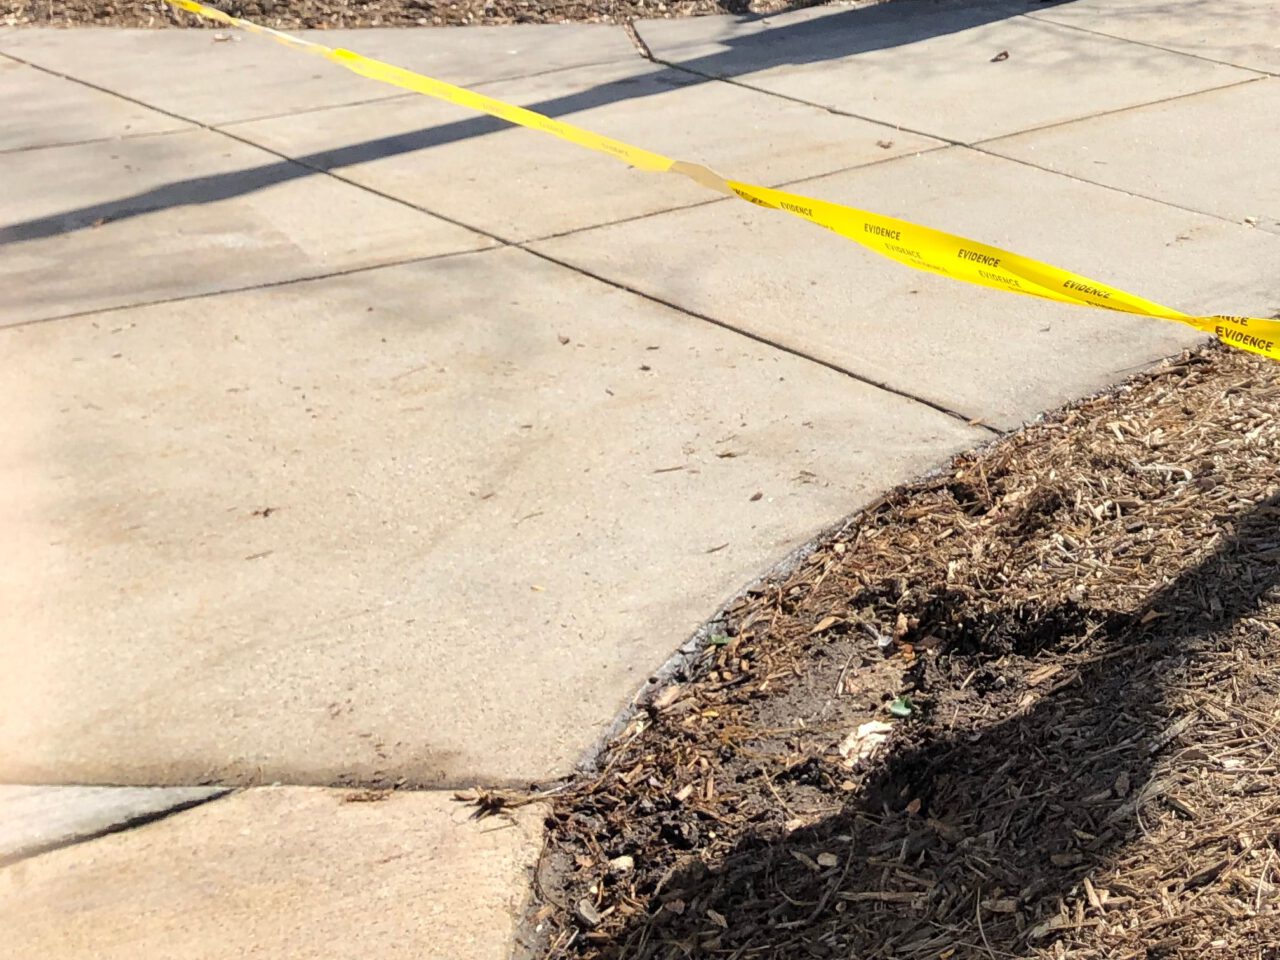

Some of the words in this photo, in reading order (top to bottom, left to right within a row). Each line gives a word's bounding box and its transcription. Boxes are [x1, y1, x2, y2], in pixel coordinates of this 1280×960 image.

[780, 201, 814, 217] EVIDENCE
[864, 223, 901, 241] EVIDENCE
[957, 248, 1001, 268] EVIDENCE
[978, 270, 1022, 288] EVIDENCE
[1063, 279, 1112, 299] EVIDENCE
[1215, 325, 1274, 352] EVIDENCE
